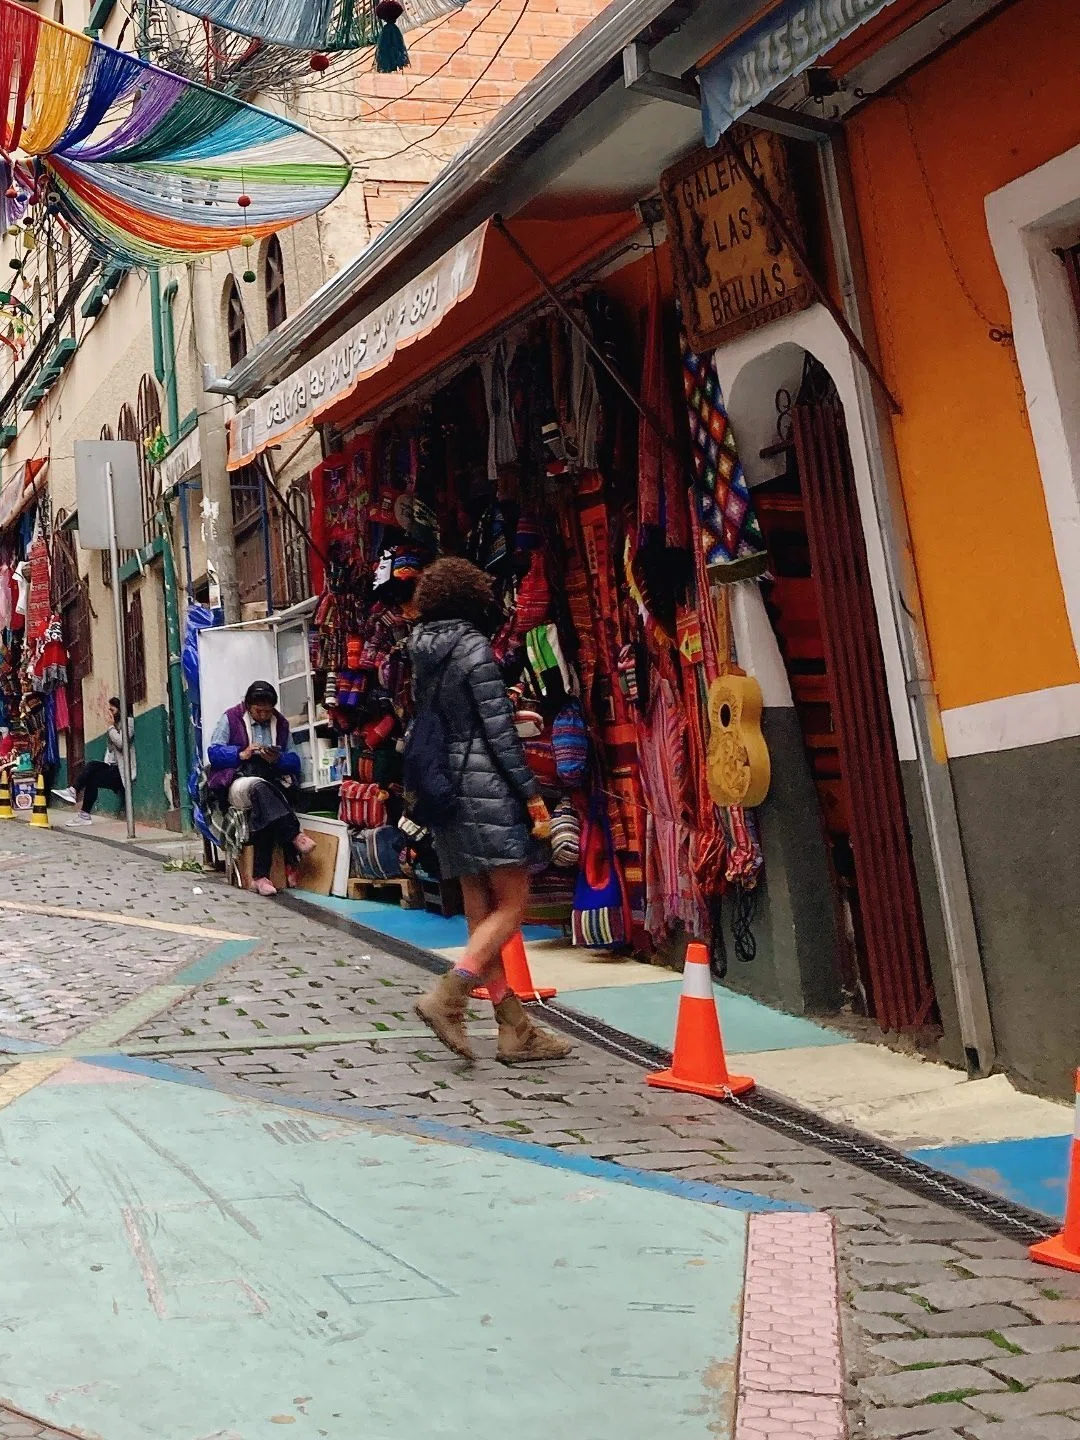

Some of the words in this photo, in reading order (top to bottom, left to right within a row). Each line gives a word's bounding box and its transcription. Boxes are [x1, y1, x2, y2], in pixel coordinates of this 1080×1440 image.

[682, 139, 762, 210] GALERA
[712, 206, 752, 252] LAS
[410, 272, 440, 326] 891
[709, 262, 786, 325] BRUJAS
